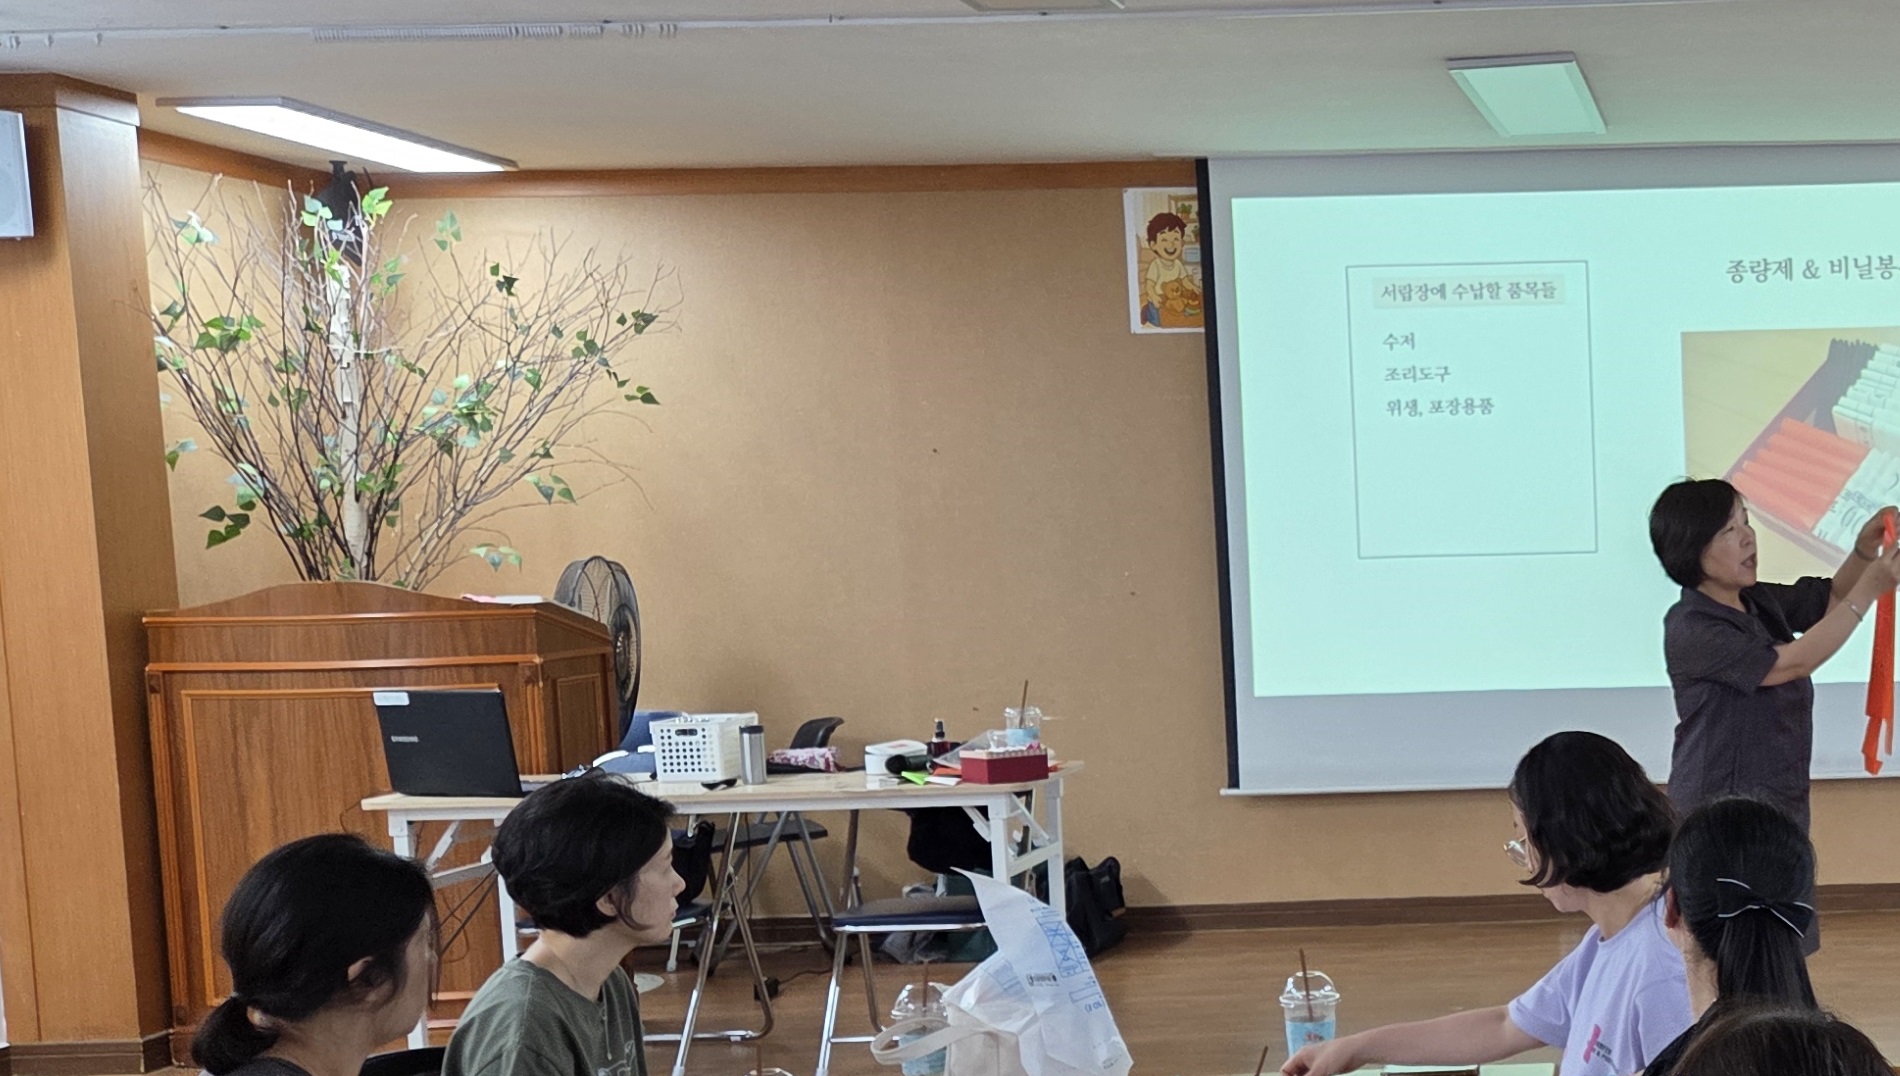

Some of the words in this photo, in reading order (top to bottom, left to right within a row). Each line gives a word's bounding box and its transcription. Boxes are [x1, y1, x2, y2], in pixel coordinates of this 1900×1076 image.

[1726, 257, 1794, 284] 종량제
[1802, 259, 1821, 280] &
[1452, 282, 1502, 301] 수납할
[1506, 281, 1557, 300] 품목들
[1382, 332, 1416, 351] 수저
[1384, 365, 1451, 383] 조리도구
[1386, 399, 1423, 417] 위생,
[1428, 397, 1495, 416] 포장용품
